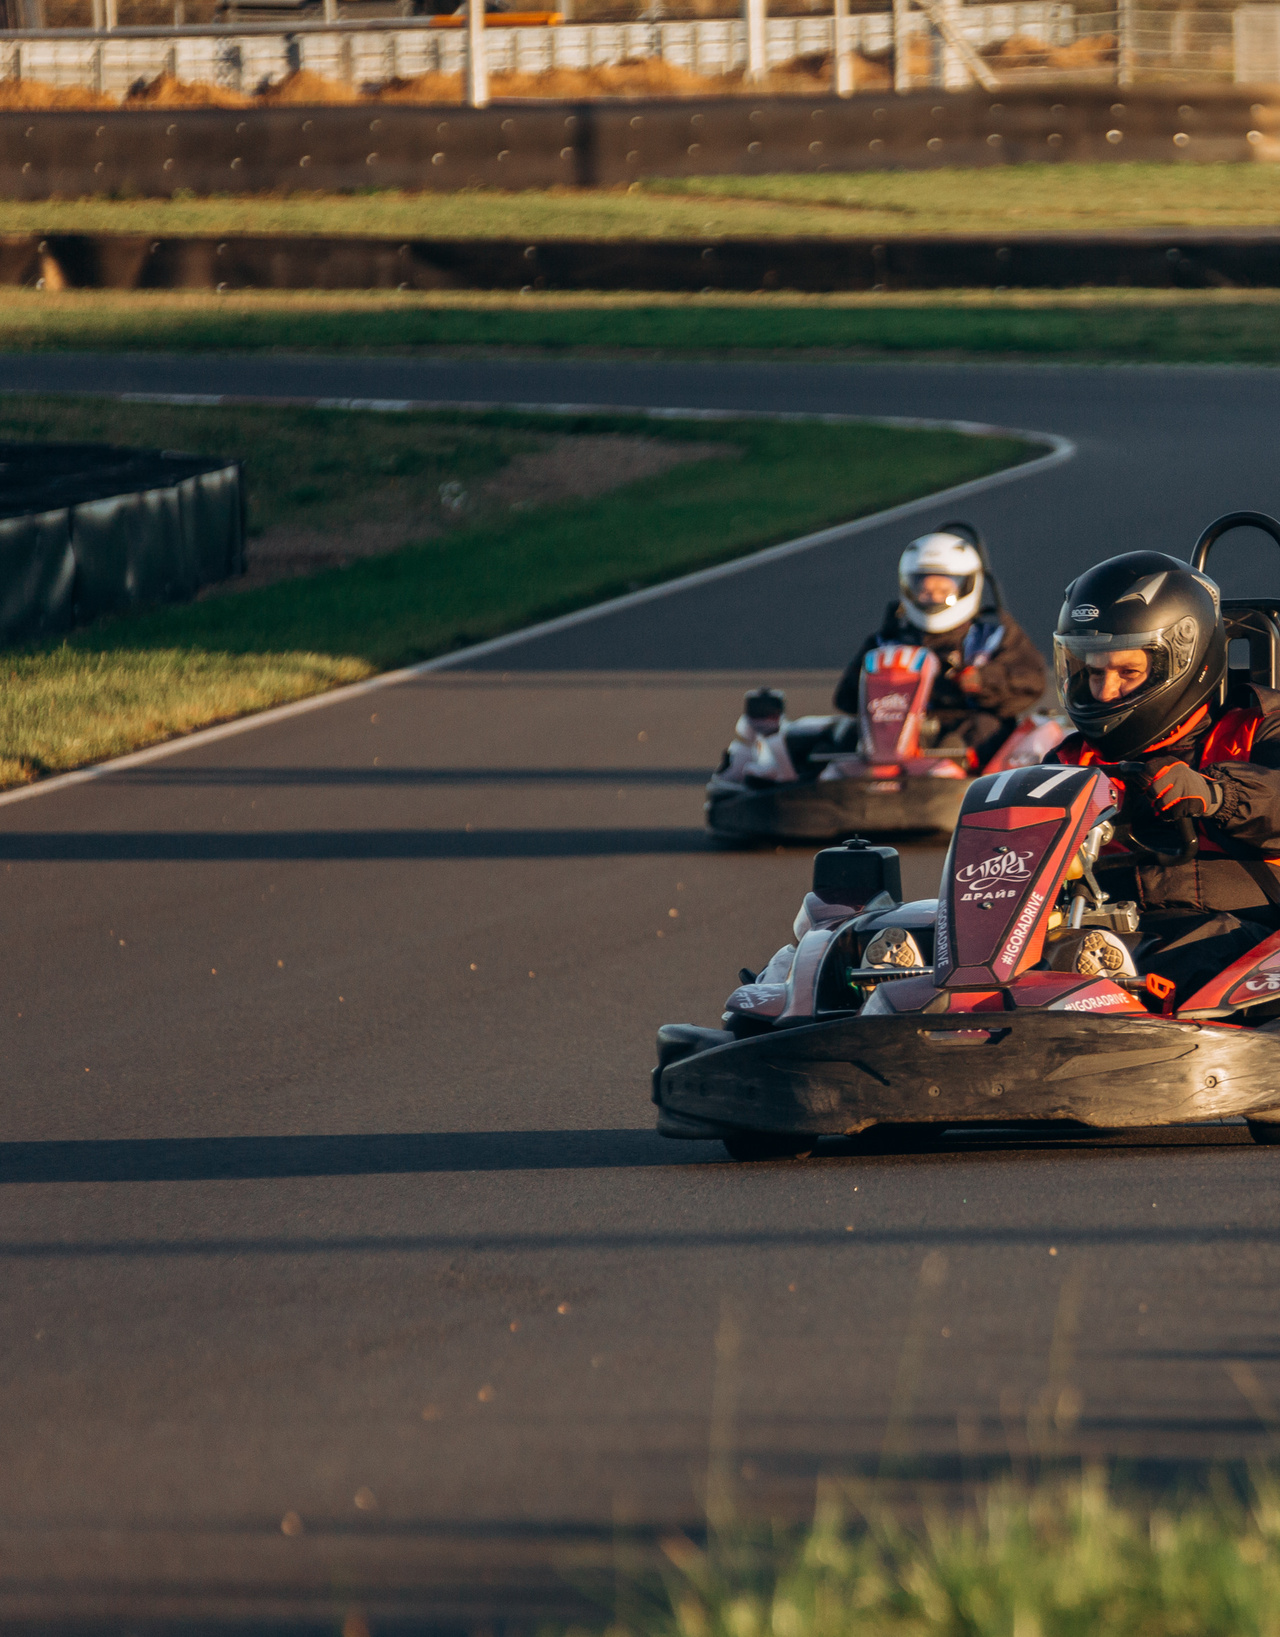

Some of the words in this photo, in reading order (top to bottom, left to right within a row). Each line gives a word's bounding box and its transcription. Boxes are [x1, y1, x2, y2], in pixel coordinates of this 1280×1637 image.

[1071, 608, 1100, 621] sparco
[985, 766, 1089, 803] 17
[960, 889, 1017, 901] ДРАЙВ
[1001, 891, 1044, 966] #IGORADRIVE
